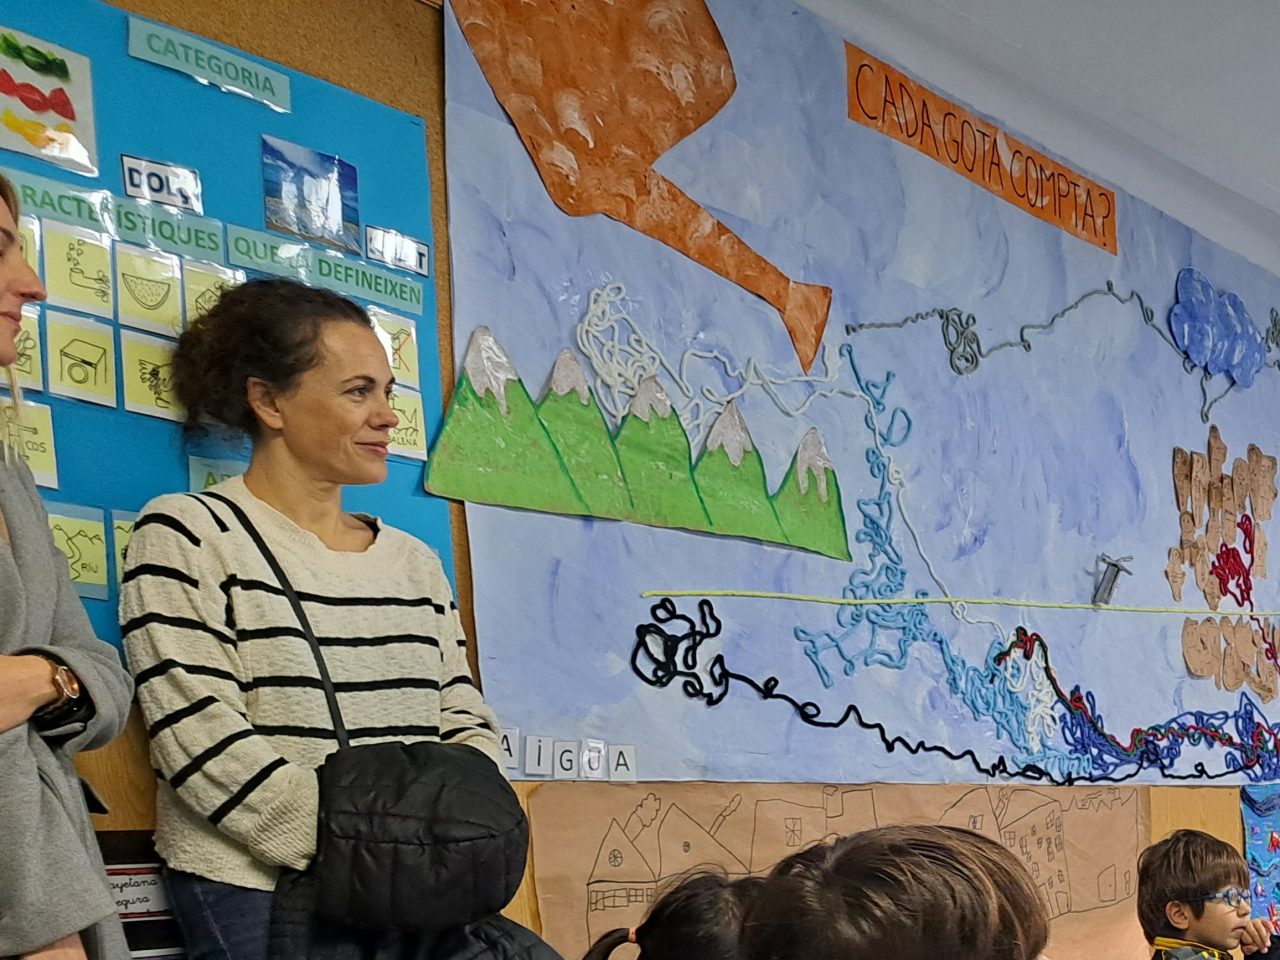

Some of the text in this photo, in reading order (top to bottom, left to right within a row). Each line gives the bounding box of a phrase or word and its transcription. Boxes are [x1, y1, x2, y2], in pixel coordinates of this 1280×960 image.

[146, 33, 276, 96] CATEGORIA
[127, 166, 190, 205] DOL
[855, 63, 1112, 248] CADA GOTA COMPTA?
[233, 236, 282, 264] QUE
[318, 258, 422, 306] DEFINEIXEN
[115, 895, 151, 910] egura
